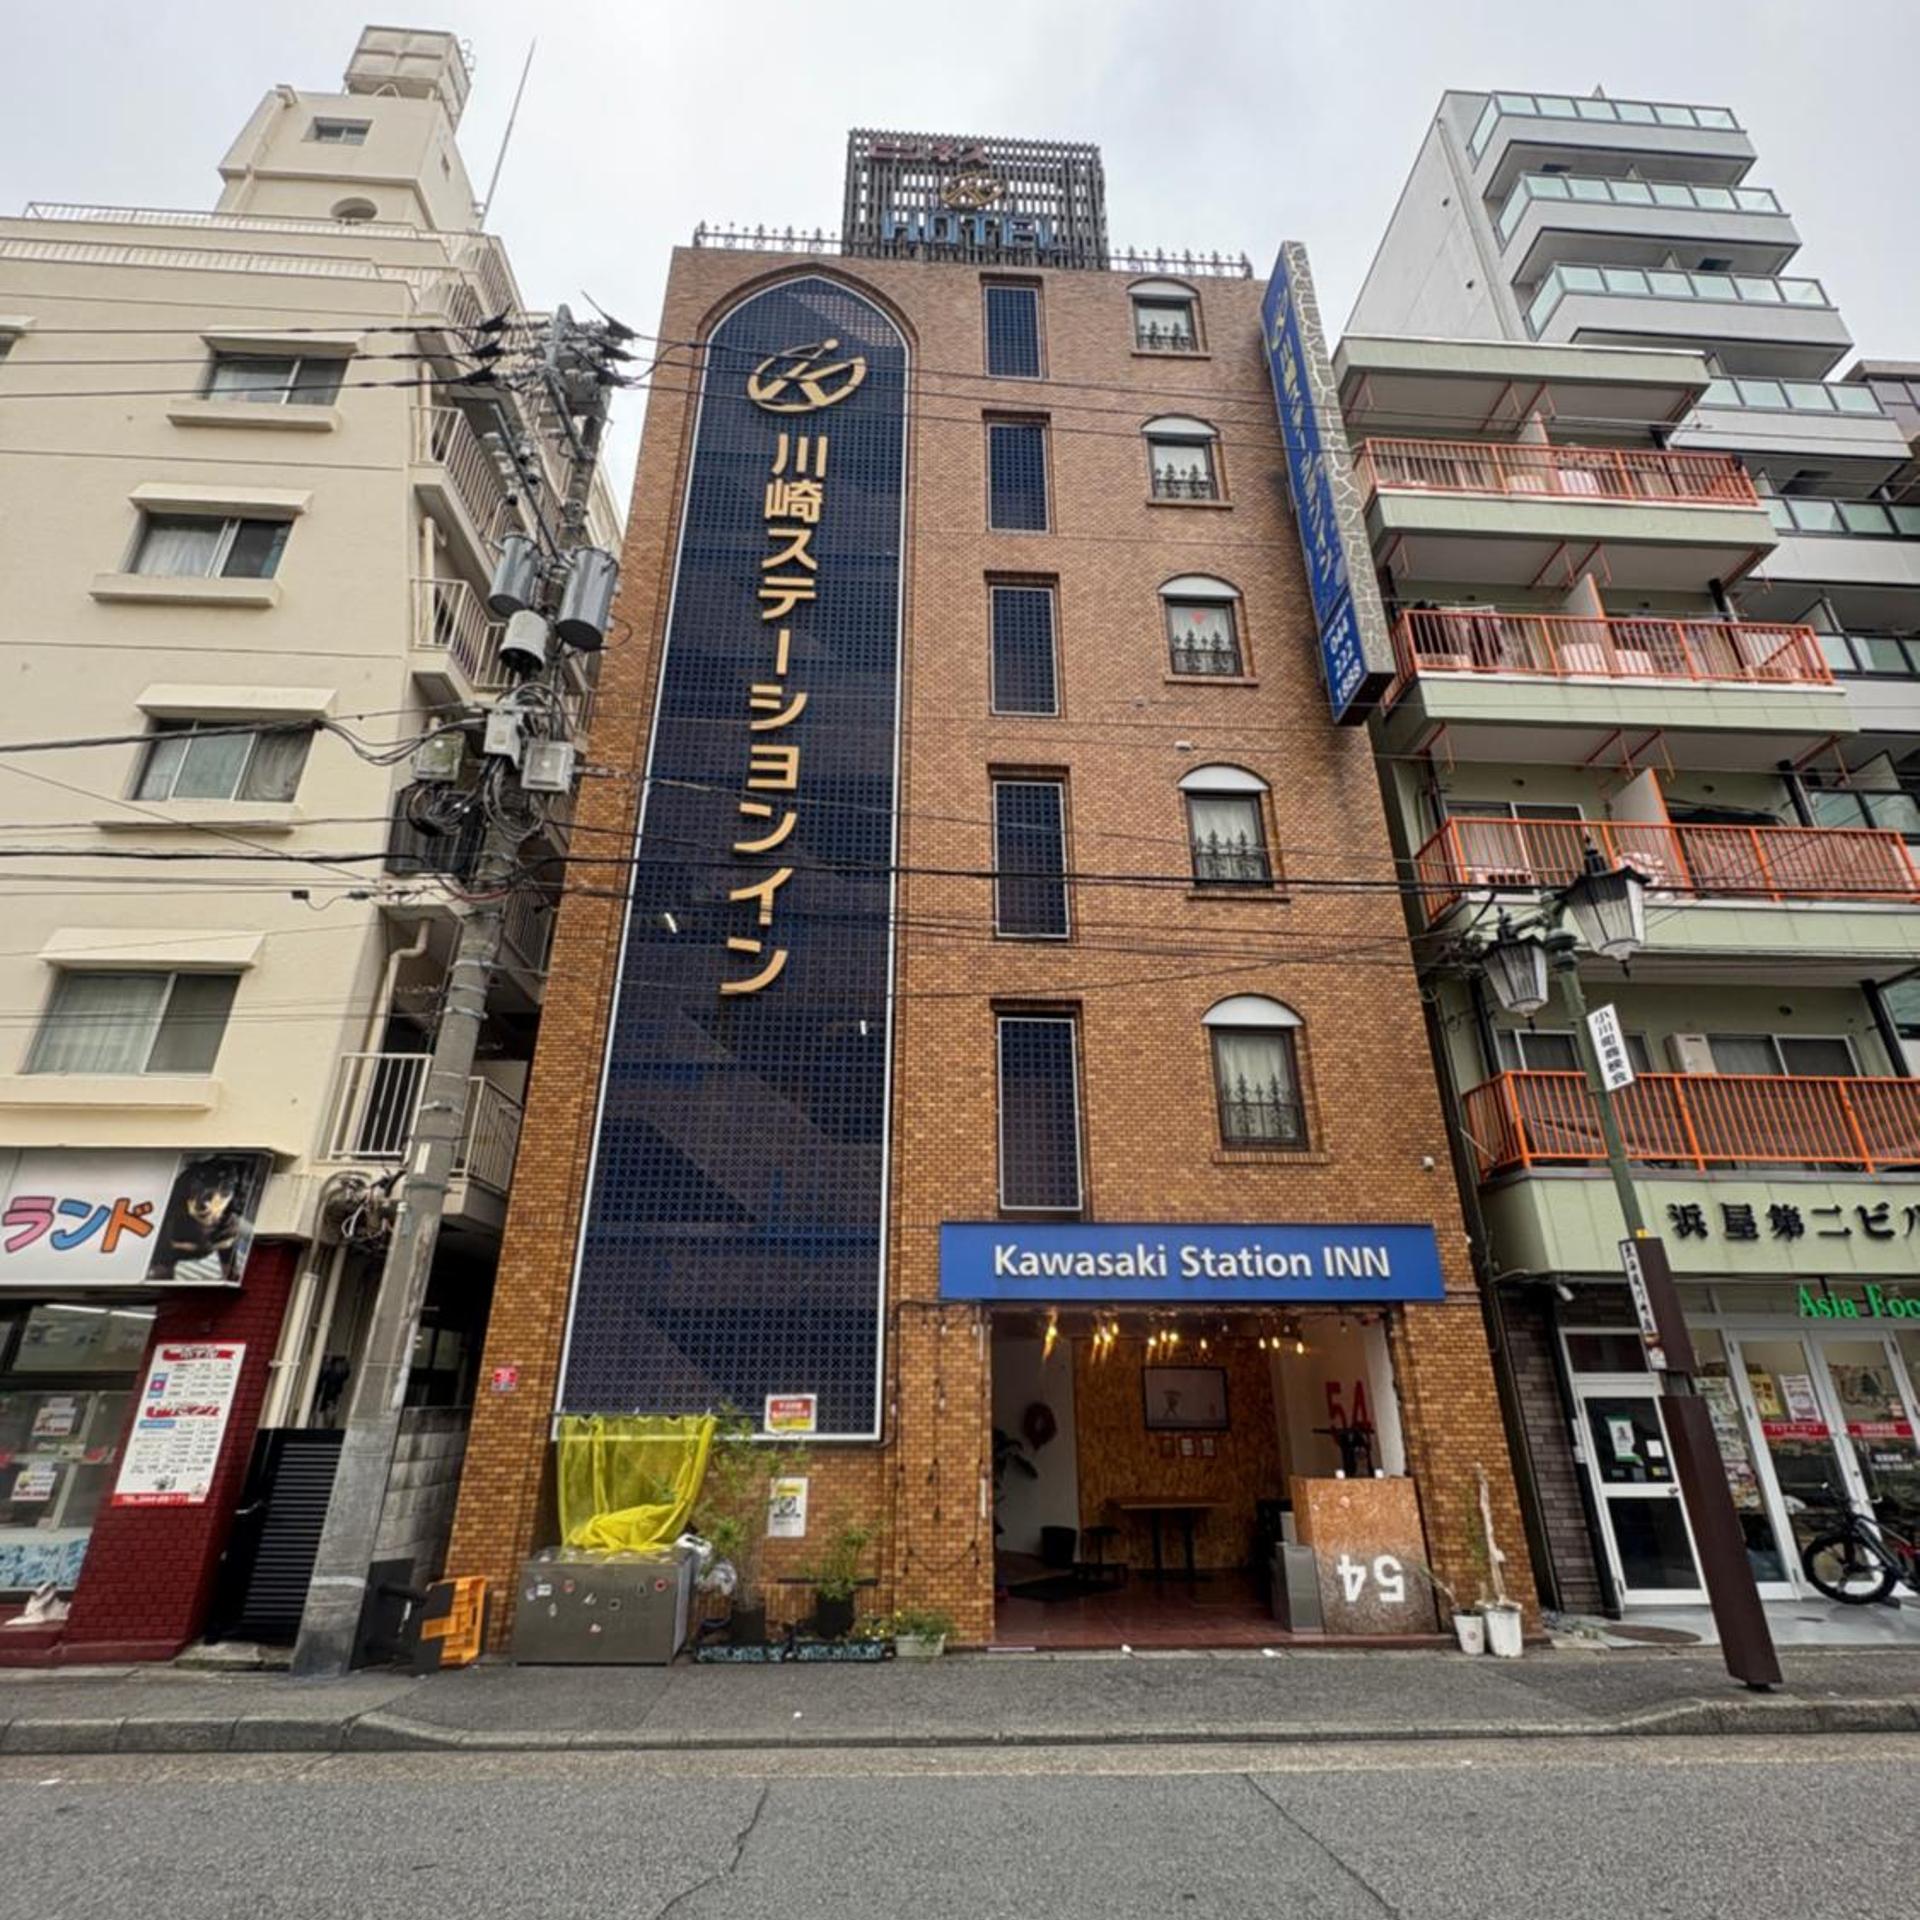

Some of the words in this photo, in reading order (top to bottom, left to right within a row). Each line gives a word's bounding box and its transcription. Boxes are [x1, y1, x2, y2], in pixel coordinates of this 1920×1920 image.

[2, 1195, 154, 1253] ランド
[994, 1243, 1168, 1278] Kawasaki
[1180, 1244, 1312, 1279] Station
[1324, 1246, 1391, 1279] INN
[1799, 1284, 1859, 1319] Asia
[1336, 1554, 1405, 1602] 54
